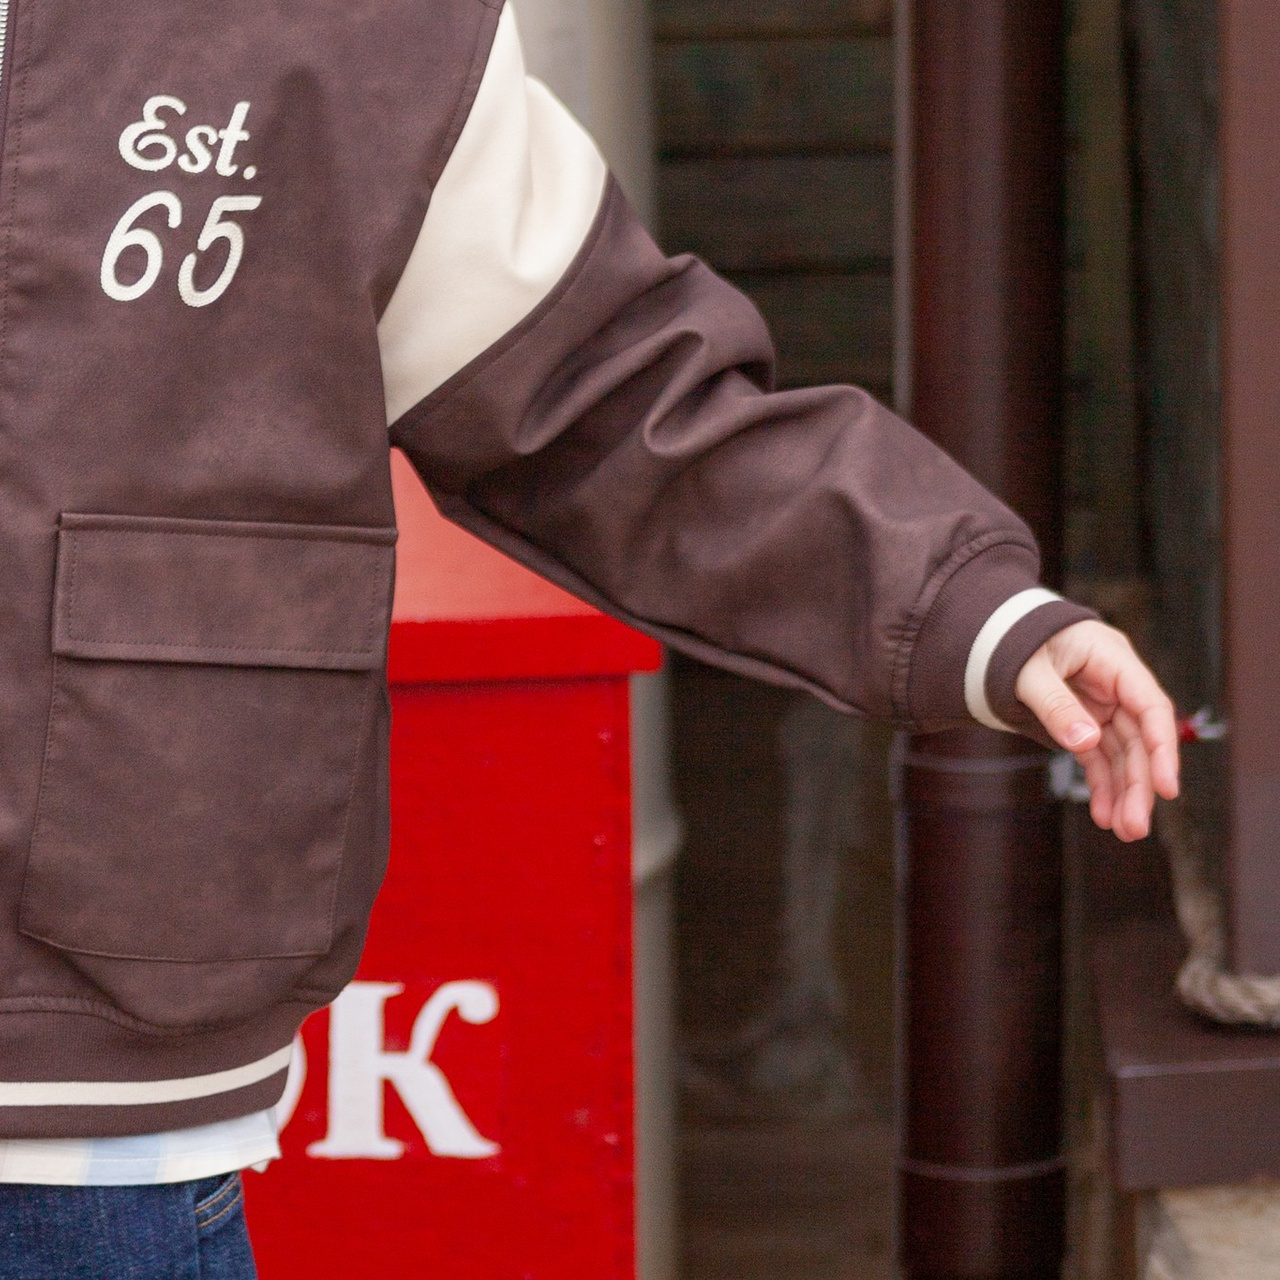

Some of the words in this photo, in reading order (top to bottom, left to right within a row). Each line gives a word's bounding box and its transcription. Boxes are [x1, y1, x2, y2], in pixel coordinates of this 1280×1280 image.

[118, 94, 257, 180] Est.
[100, 190, 263, 307] 65
[275, 978, 501, 1160] К
